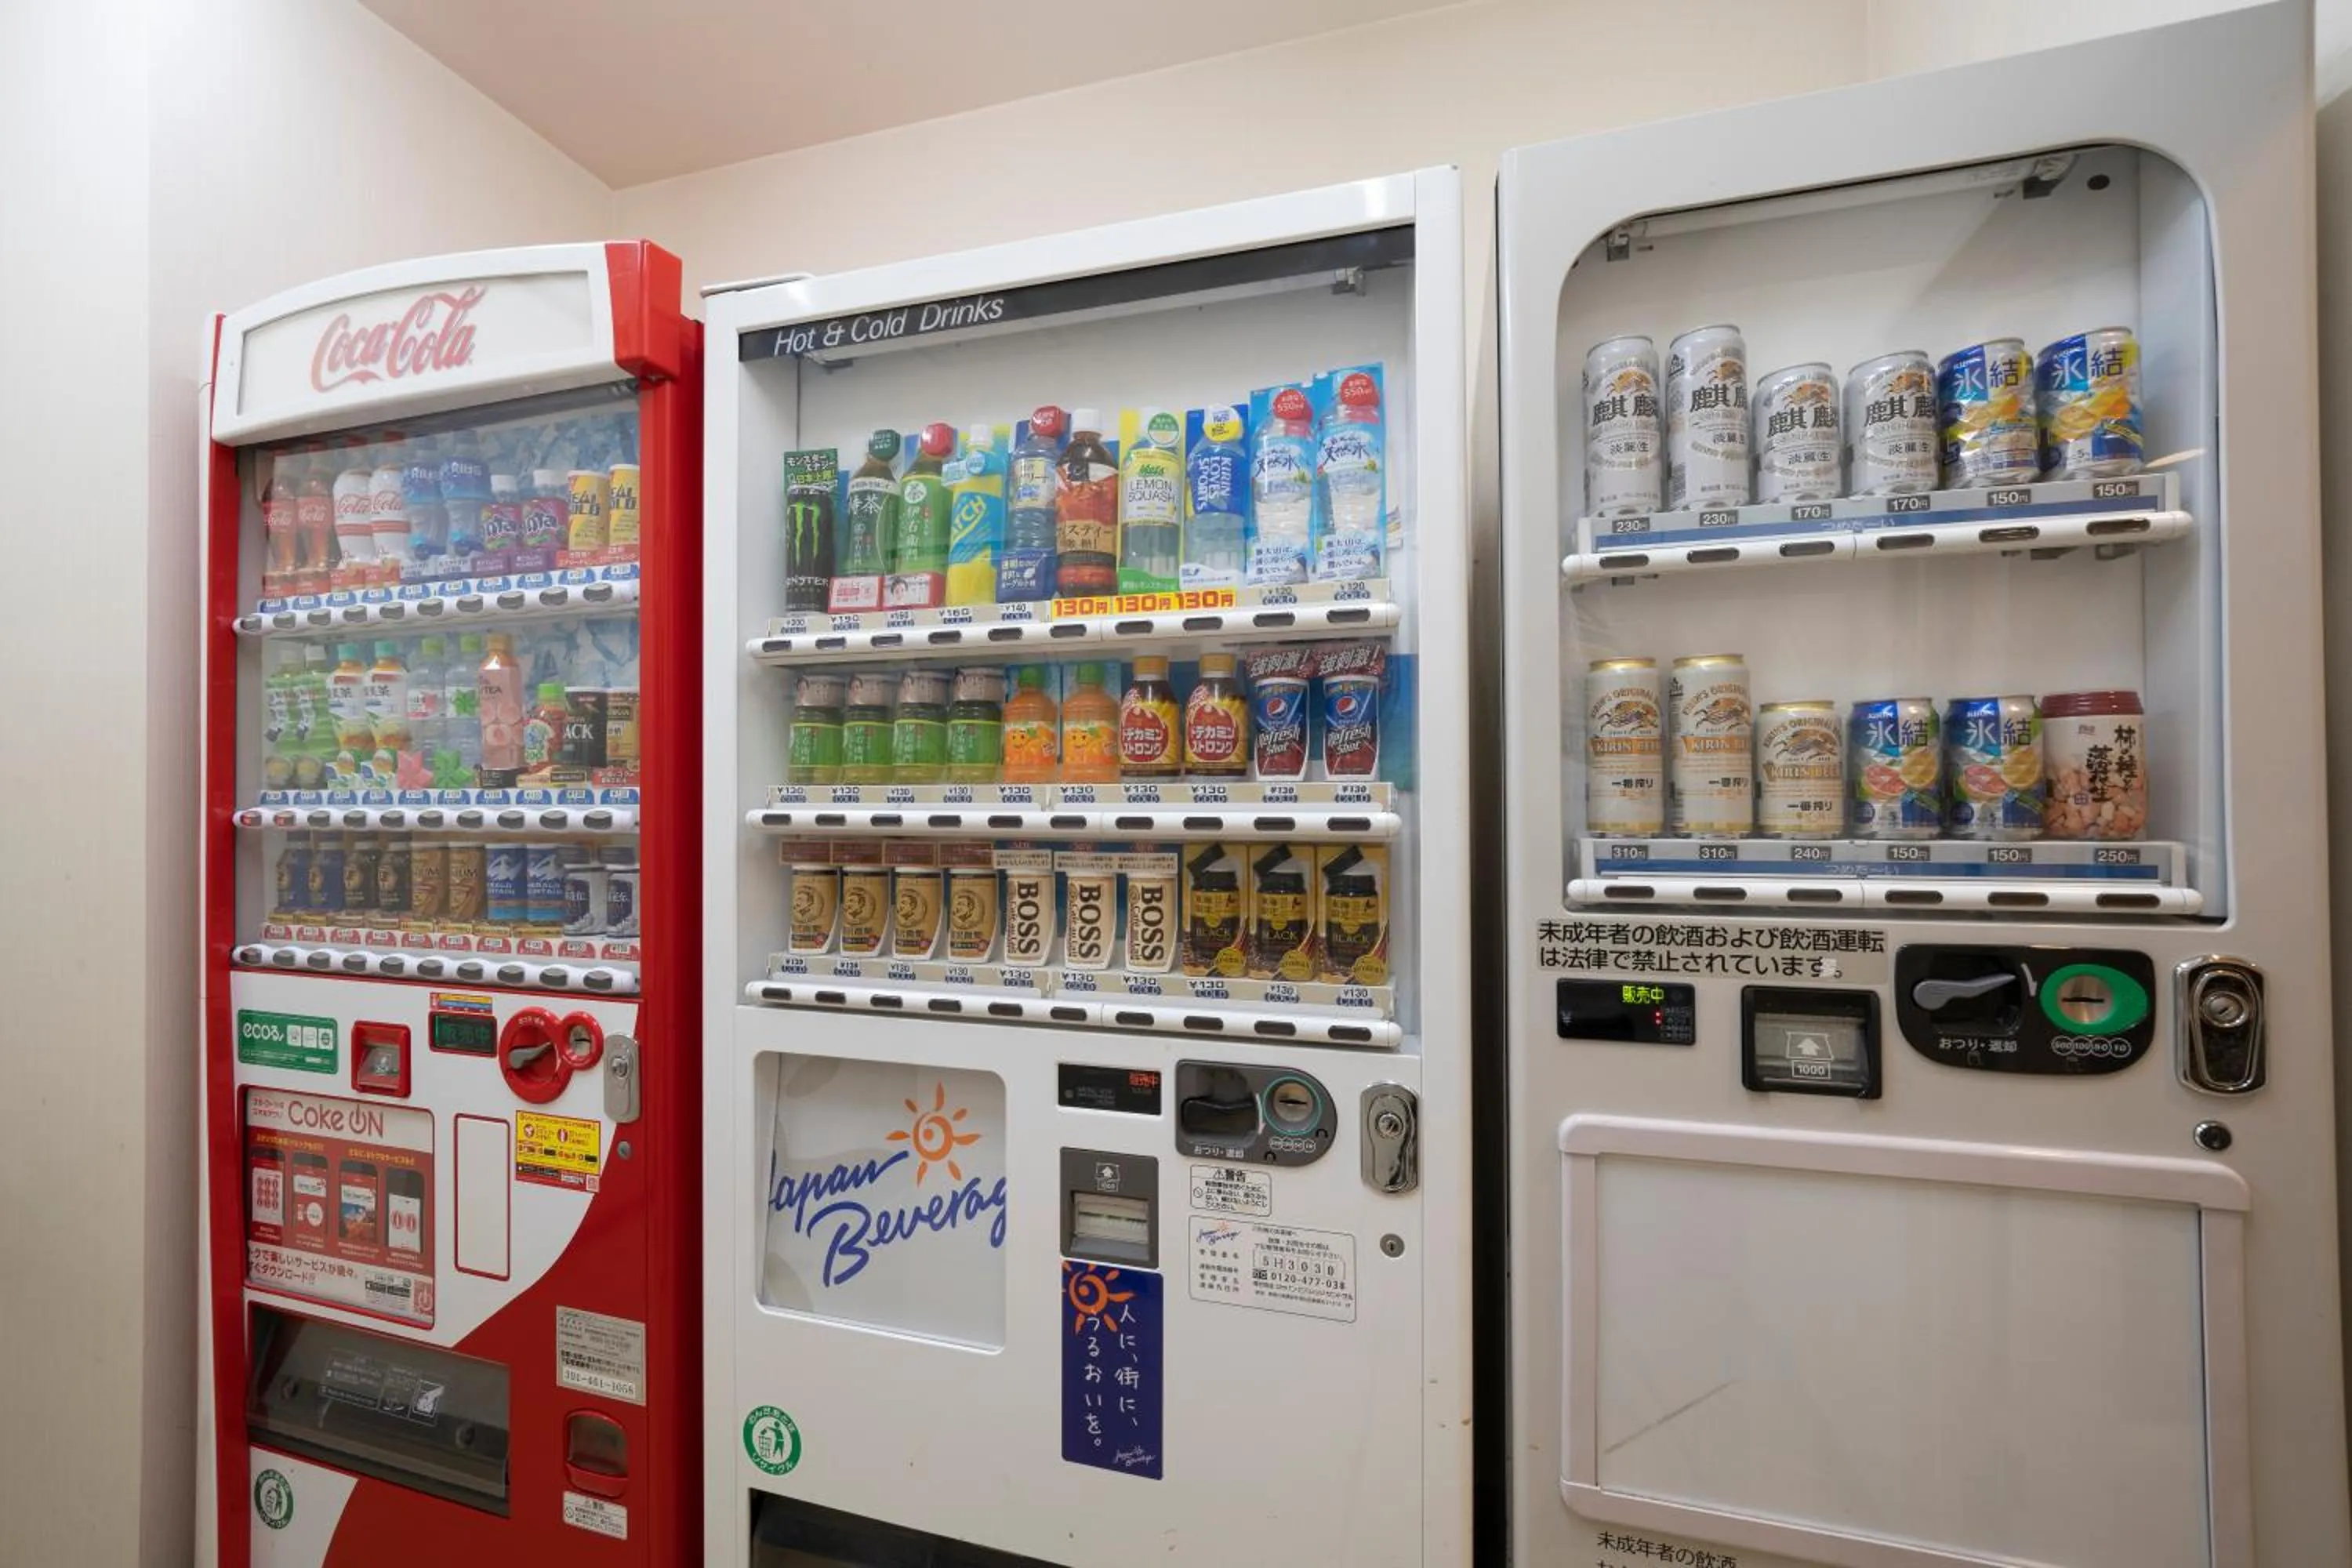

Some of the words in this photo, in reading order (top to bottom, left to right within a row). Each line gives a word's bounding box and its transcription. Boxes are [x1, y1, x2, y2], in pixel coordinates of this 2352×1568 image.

[773, 328, 815, 358] Hot
[822, 322, 844, 347] &
[850, 313, 906, 344] Cold
[919, 298, 1005, 332] Drinks
[312, 283, 488, 392] Coca-Cola
[2050, 347, 2124, 388] 氷結
[1954, 358, 2020, 401] 氷結
[1129, 477, 1173, 492] LEMON
[1197, 457, 1209, 511] SPORTS
[1209, 456, 1221, 500] LOVES
[1221, 456, 1232, 497] KIRIN
[570, 489, 596, 503] EAL
[1128, 488, 1176, 503] SQUASH
[1991, 491, 2029, 505] 150円
[2096, 483, 2136, 497] 150円
[1890, 497, 1929, 510] 170円
[1054, 599, 1109, 616] 130円
[1116, 595, 1171, 612] 130円
[1176, 591, 1234, 608] 130円
[564, 722, 594, 740] ACK
[1866, 718, 1928, 746] 氷結
[1965, 717, 2031, 746] 氷結
[1123, 785, 1158, 793] ¥130
[1192, 785, 1226, 793] ¥130
[1611, 777, 1653, 789] 一番搾り
[1788, 800, 1832, 811] 一番搾り
[1891, 848, 1928, 860] 150円
[1990, 849, 2031, 862] 150円
[2096, 850, 2138, 863] 250円
[1017, 881, 1040, 954] BOSS
[1078, 884, 1102, 959] BOSS
[1141, 887, 1164, 961] BOSS
[1539, 921, 1886, 954] 未成年者の飲酒および飲酒運転
[1541, 947, 1842, 978] は法律で禁止されています。
[1000, 970, 1031, 979] ¥130
[1062, 973, 1094, 982] ¥130
[1123, 975, 1156, 985] ¥130
[1270, 985, 1294, 996] ¥130
[1344, 989, 1368, 997] ¥130
[1621, 985, 1664, 1004] 販売中
[1939, 1037, 2018, 1053] おつり・返却
[1797, 1064, 1826, 1076] 1000
[289, 1101, 343, 1131] Coke
[350, 1105, 383, 1137] ON
[769, 1150, 909, 1232] apan
[807, 1177, 1006, 1287] Beverag
[1115, 1304, 1140, 1426] 人に、街に、
[1597, 1530, 1737, 1568] 未成年者の飲酒
